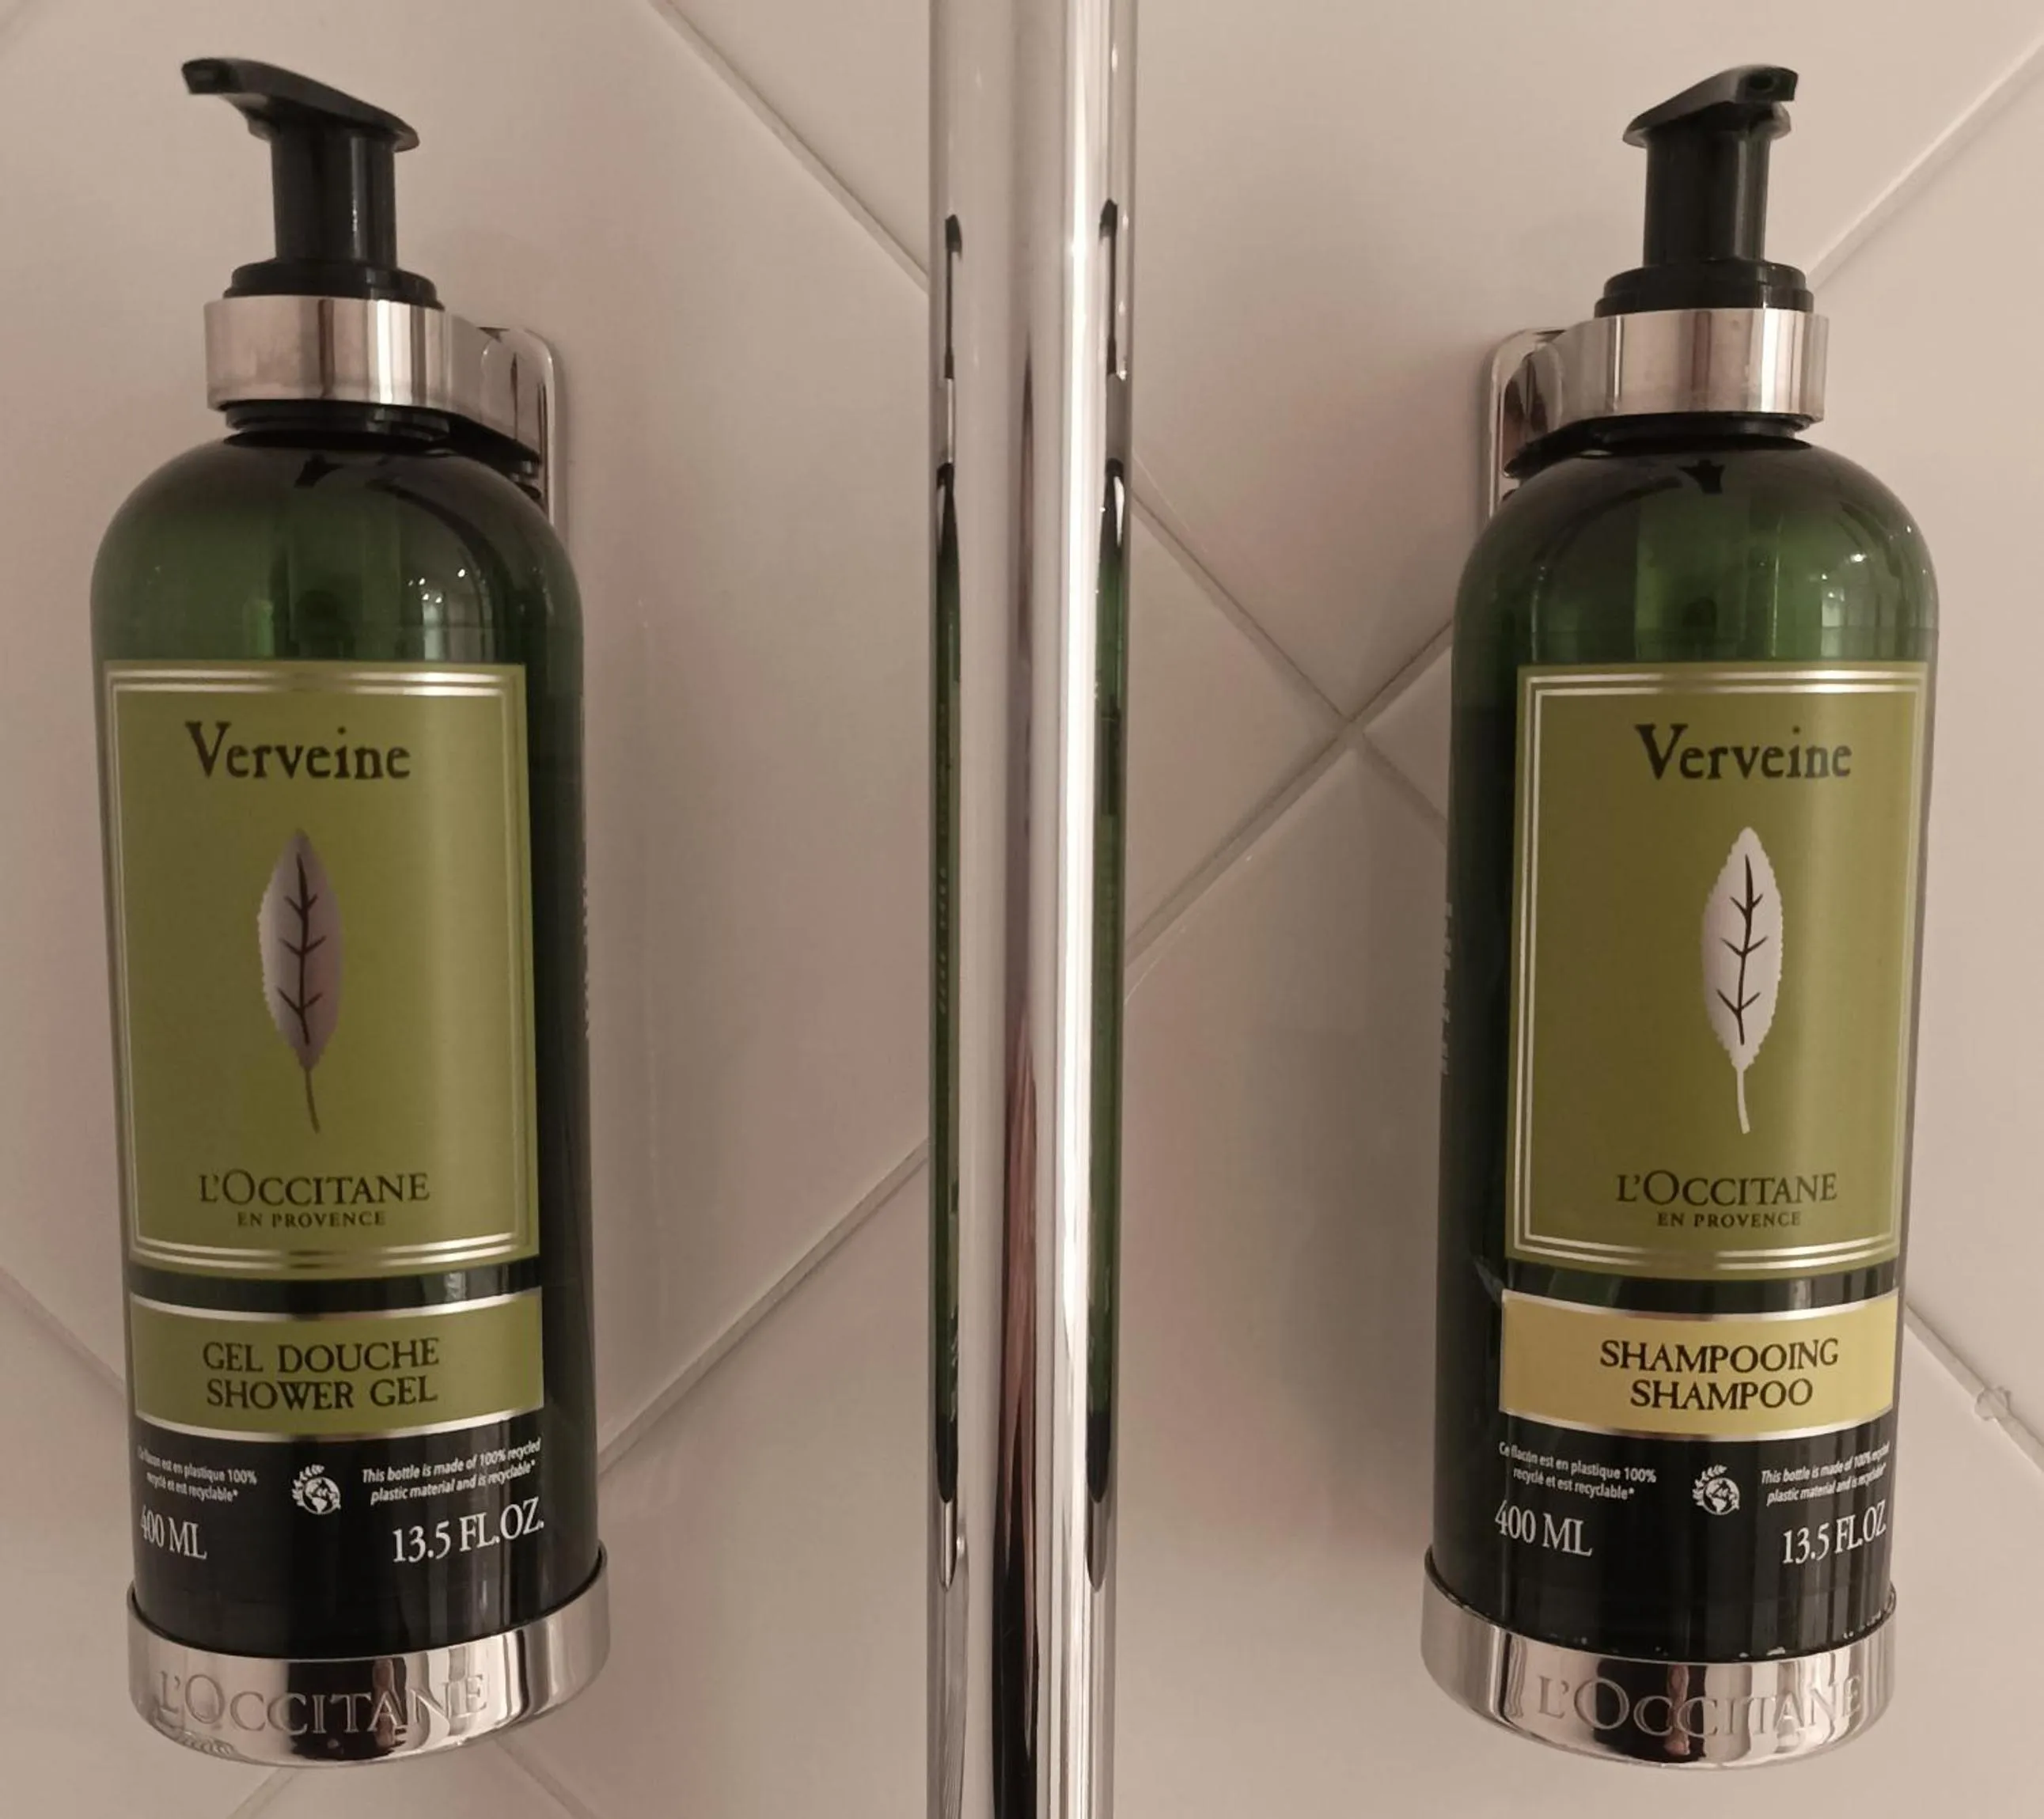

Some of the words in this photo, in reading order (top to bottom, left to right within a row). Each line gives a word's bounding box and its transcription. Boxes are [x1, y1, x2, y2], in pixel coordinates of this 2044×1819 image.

[184, 720, 411, 781] Verveine
[1634, 722, 1852, 781] Verveine
[199, 1168, 430, 1207] L'OCCITANE
[1616, 1169, 1837, 1207] L'OCCITANE
[237, 1211, 263, 1227] EN
[271, 1211, 385, 1229] PROVENCE
[1657, 1212, 1684, 1227] EN
[1693, 1211, 1800, 1230] PROVENCE
[203, 1341, 264, 1373] GEL
[277, 1336, 440, 1374] DOUCHE
[1599, 1337, 1839, 1374] SHAMPOOING
[207, 1378, 355, 1412] SHOWER
[369, 1375, 438, 1407] GEL
[1629, 1377, 1814, 1411] SHAMPOO
[227, 1469, 257, 1485] 100%
[362, 1468, 385, 1484] This
[387, 1465, 420, 1481] bottle
[422, 1464, 431, 1477] is
[434, 1457, 464, 1476] made
[466, 1453, 479, 1469] of
[480, 1450, 506, 1466] 100%
[1539, 1455, 1553, 1468] est
[1556, 1459, 1568, 1471] en
[1571, 1460, 1621, 1481] plastique
[1624, 1467, 1656, 1483] 100%
[1545, 1475, 1556, 1487] et
[1557, 1478, 1572, 1491] est
[1761, 1469, 1781, 1484] This
[1783, 1465, 1811, 1482] bottle
[1811, 1466, 1819, 1479] is
[370, 1487, 408, 1506] plastic
[409, 1479, 456, 1497] material
[456, 1474, 476, 1491] and
[478, 1474, 487, 1487] is
[1766, 1487, 1799, 1507] plastic
[141, 1504, 165, 1548] 400
[168, 1516, 207, 1559] ML
[392, 1520, 452, 1563] 13.5
[1495, 1500, 1536, 1544] 400
[1542, 1512, 1593, 1557] ML
[1782, 1522, 1830, 1564] 13.5
[159, 1670, 488, 1737] L'OCCITANE
[1537, 1673, 1864, 1738] L'OCCITANE
